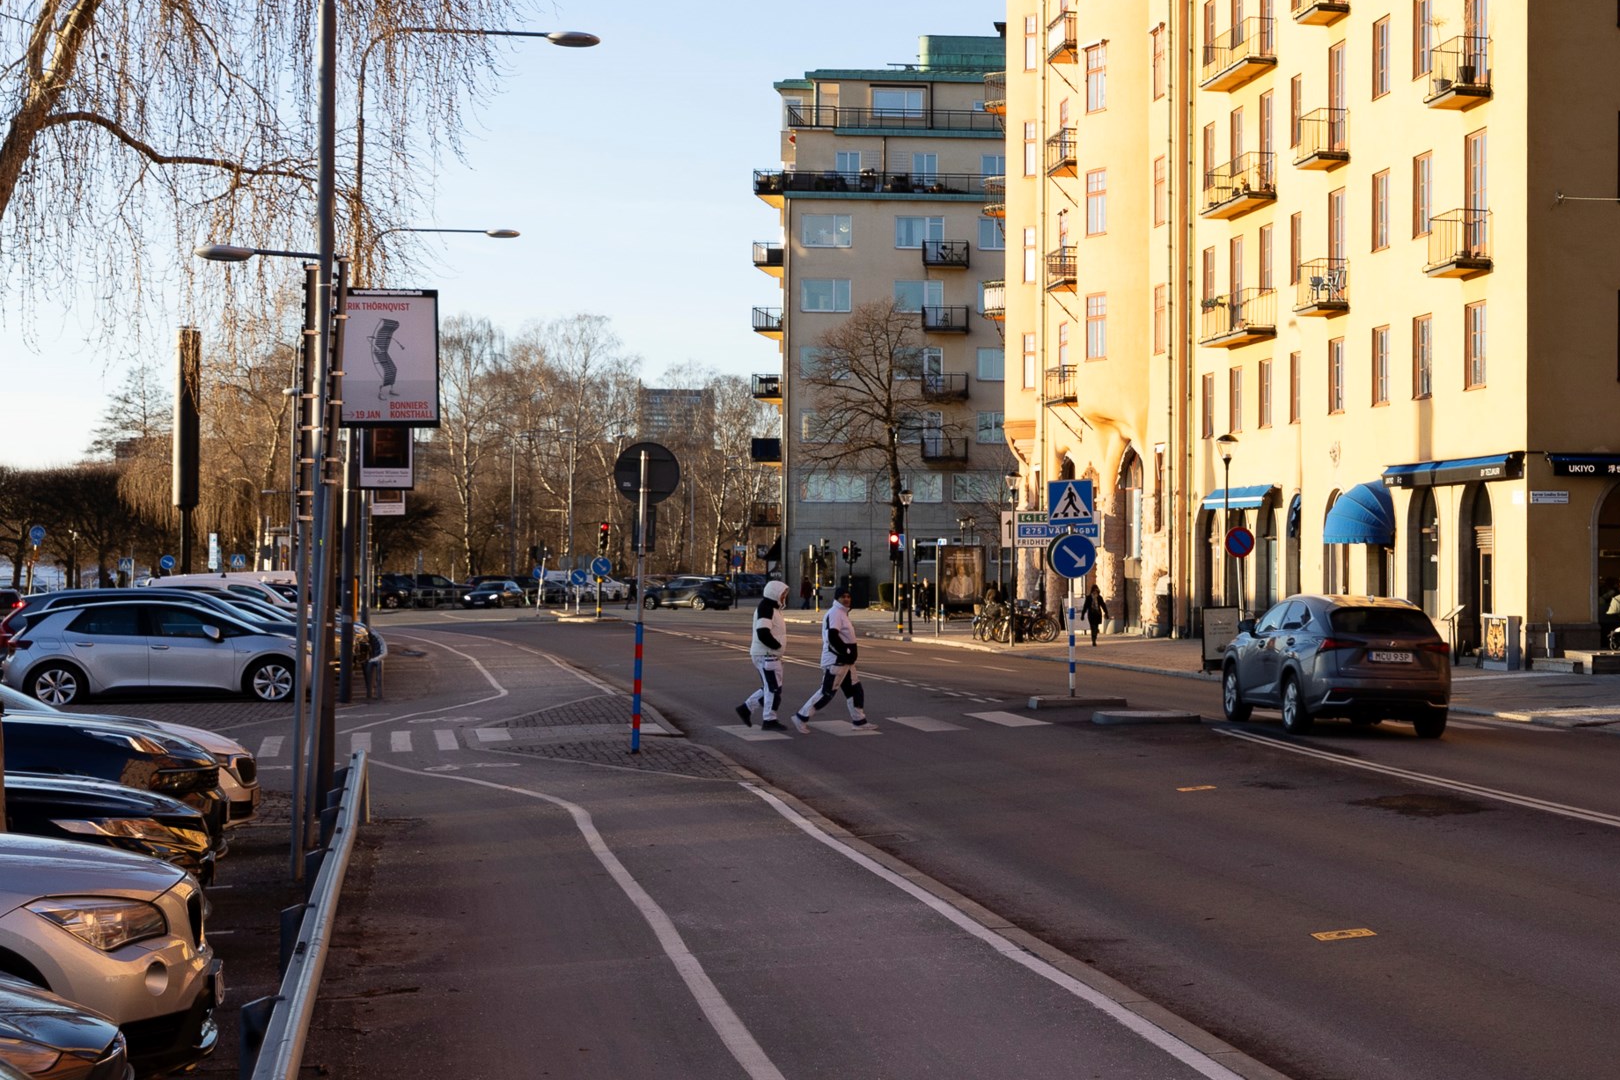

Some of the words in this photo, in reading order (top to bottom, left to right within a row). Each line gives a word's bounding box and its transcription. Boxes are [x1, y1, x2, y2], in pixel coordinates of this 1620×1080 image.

[362, 301, 411, 312] THÖRNQVIST
[389, 401, 429, 410] BONNIERS
[355, 410, 365, 419] 19
[366, 410, 381, 419] JAN
[390, 410, 434, 419] KONSTHALL
[1568, 464, 1596, 473] UKIYO
[1021, 514, 1032, 522] E4
[1025, 527, 1042, 535] 275
[1048, 526, 1096, 535] VÄLNGBY
